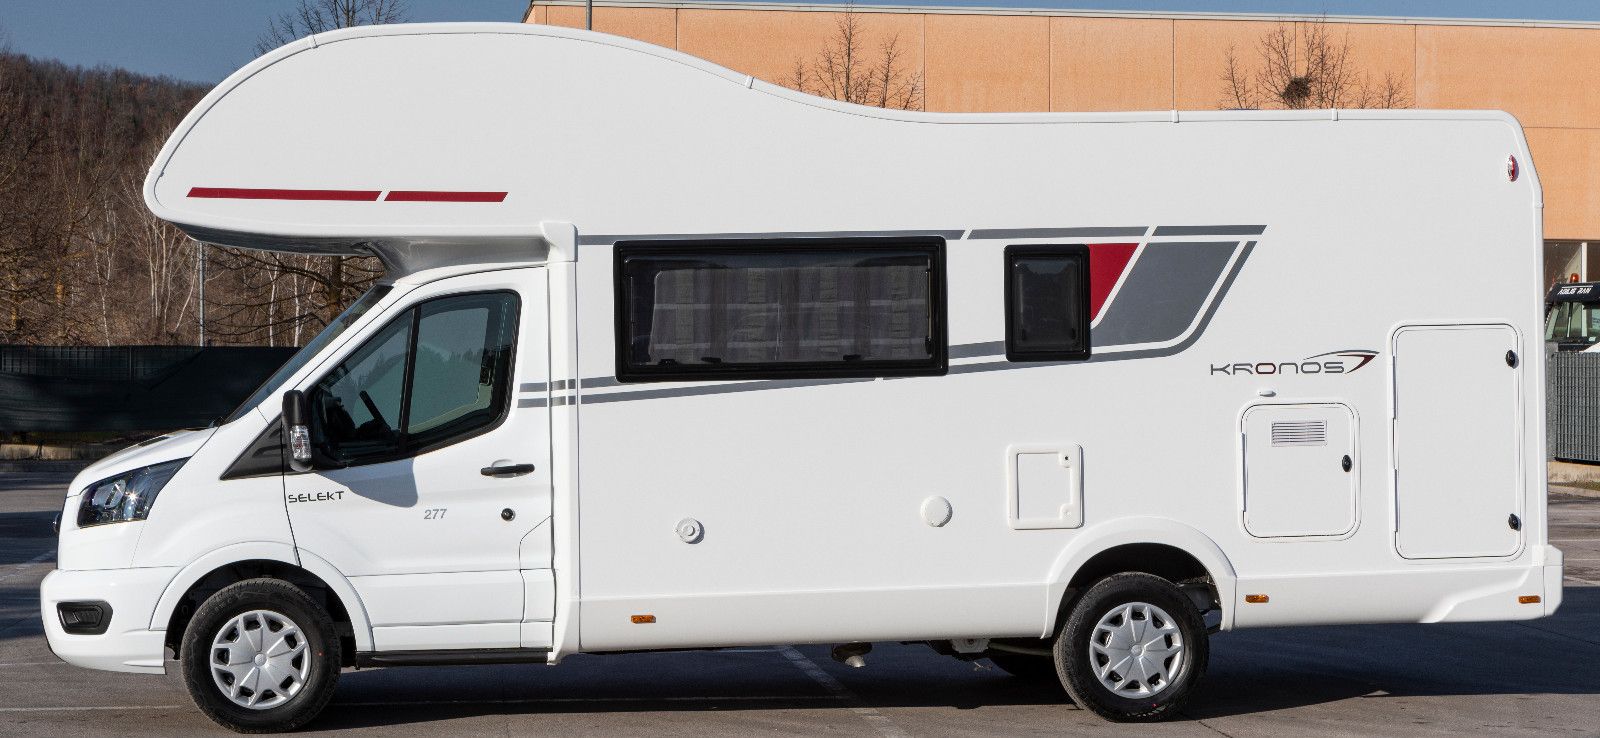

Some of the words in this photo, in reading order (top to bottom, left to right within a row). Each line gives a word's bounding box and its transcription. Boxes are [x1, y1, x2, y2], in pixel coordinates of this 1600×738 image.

[1210, 361, 1345, 375] KRONOS
[288, 490, 345, 503] SELEKT
[423, 508, 447, 520] 277
